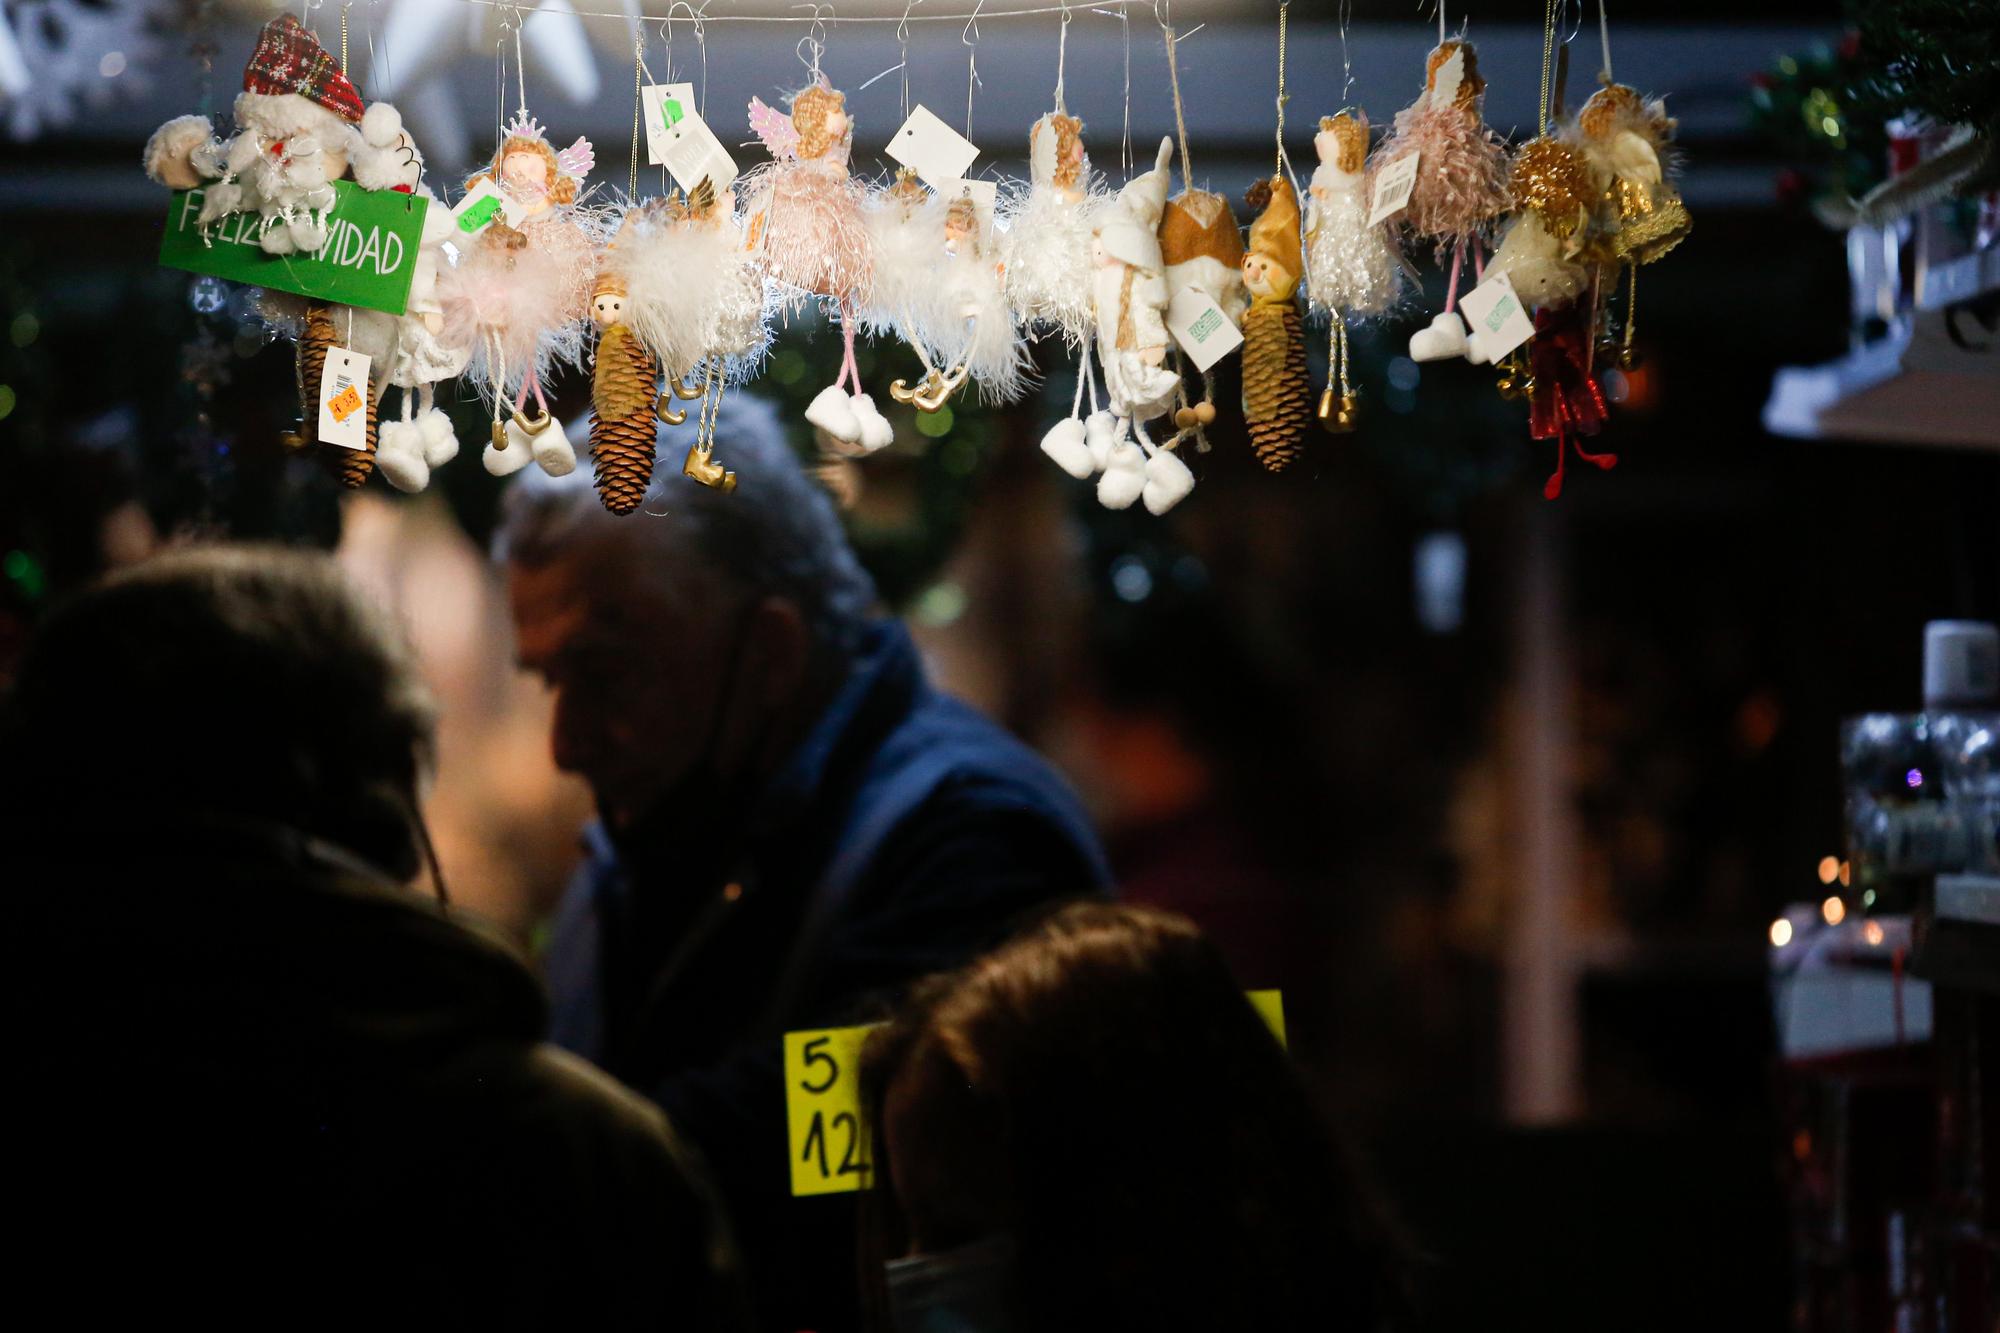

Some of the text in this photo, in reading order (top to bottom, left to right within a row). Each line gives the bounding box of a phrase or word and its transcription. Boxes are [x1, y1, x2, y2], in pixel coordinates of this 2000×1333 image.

[288, 216, 404, 276] VIDAD
[801, 1036, 839, 1094] 5
[802, 1109, 871, 1179] 12
